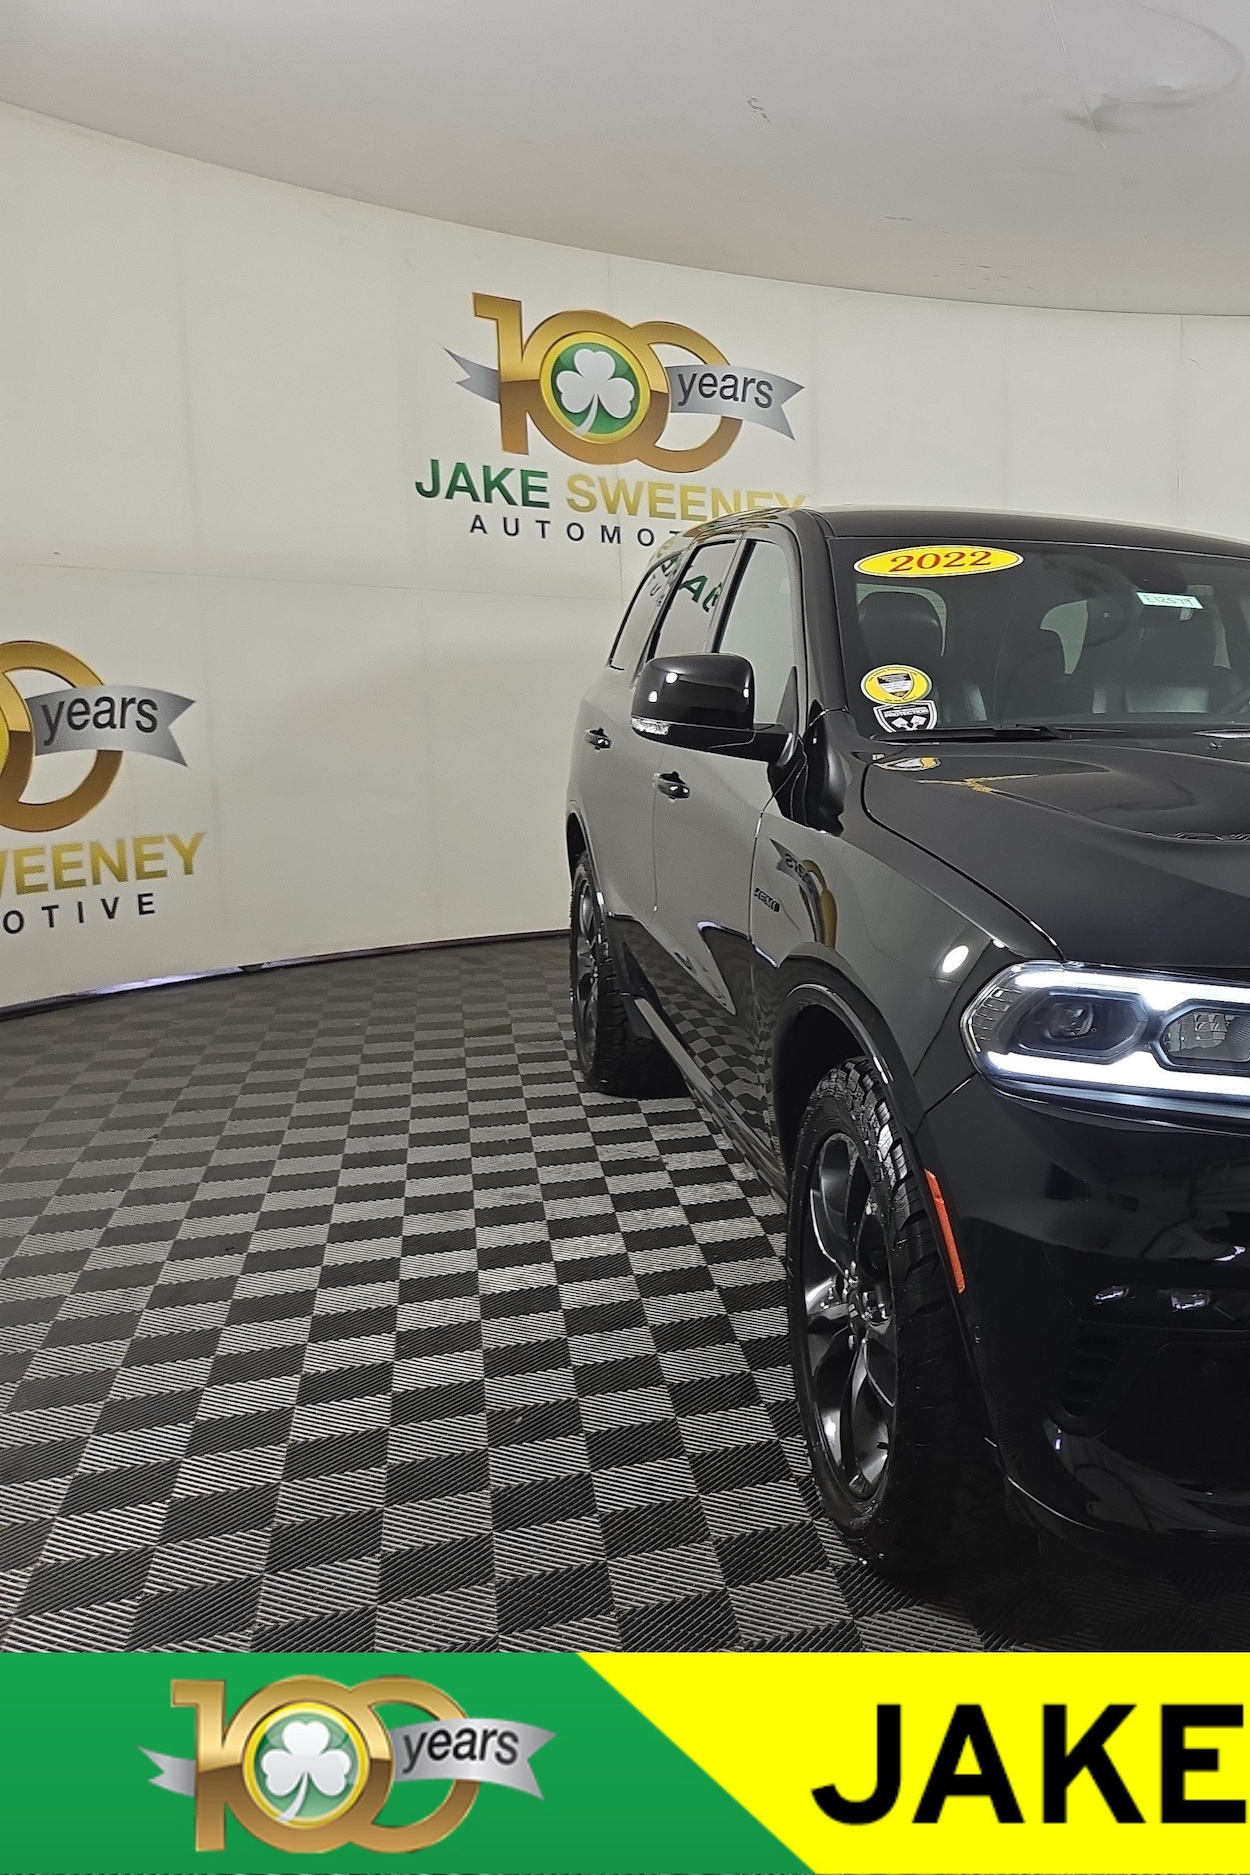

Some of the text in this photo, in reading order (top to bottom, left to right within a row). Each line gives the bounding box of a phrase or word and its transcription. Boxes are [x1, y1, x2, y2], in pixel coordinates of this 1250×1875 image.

[677, 367, 774, 408] years
[415, 458, 551, 509] JAKE
[470, 514, 688, 547] AUTOMO
[889, 551, 992, 572] 2022
[41, 695, 158, 747] years
[0, 832, 206, 897] EENEY
[3, 893, 155, 934] OTIVE
